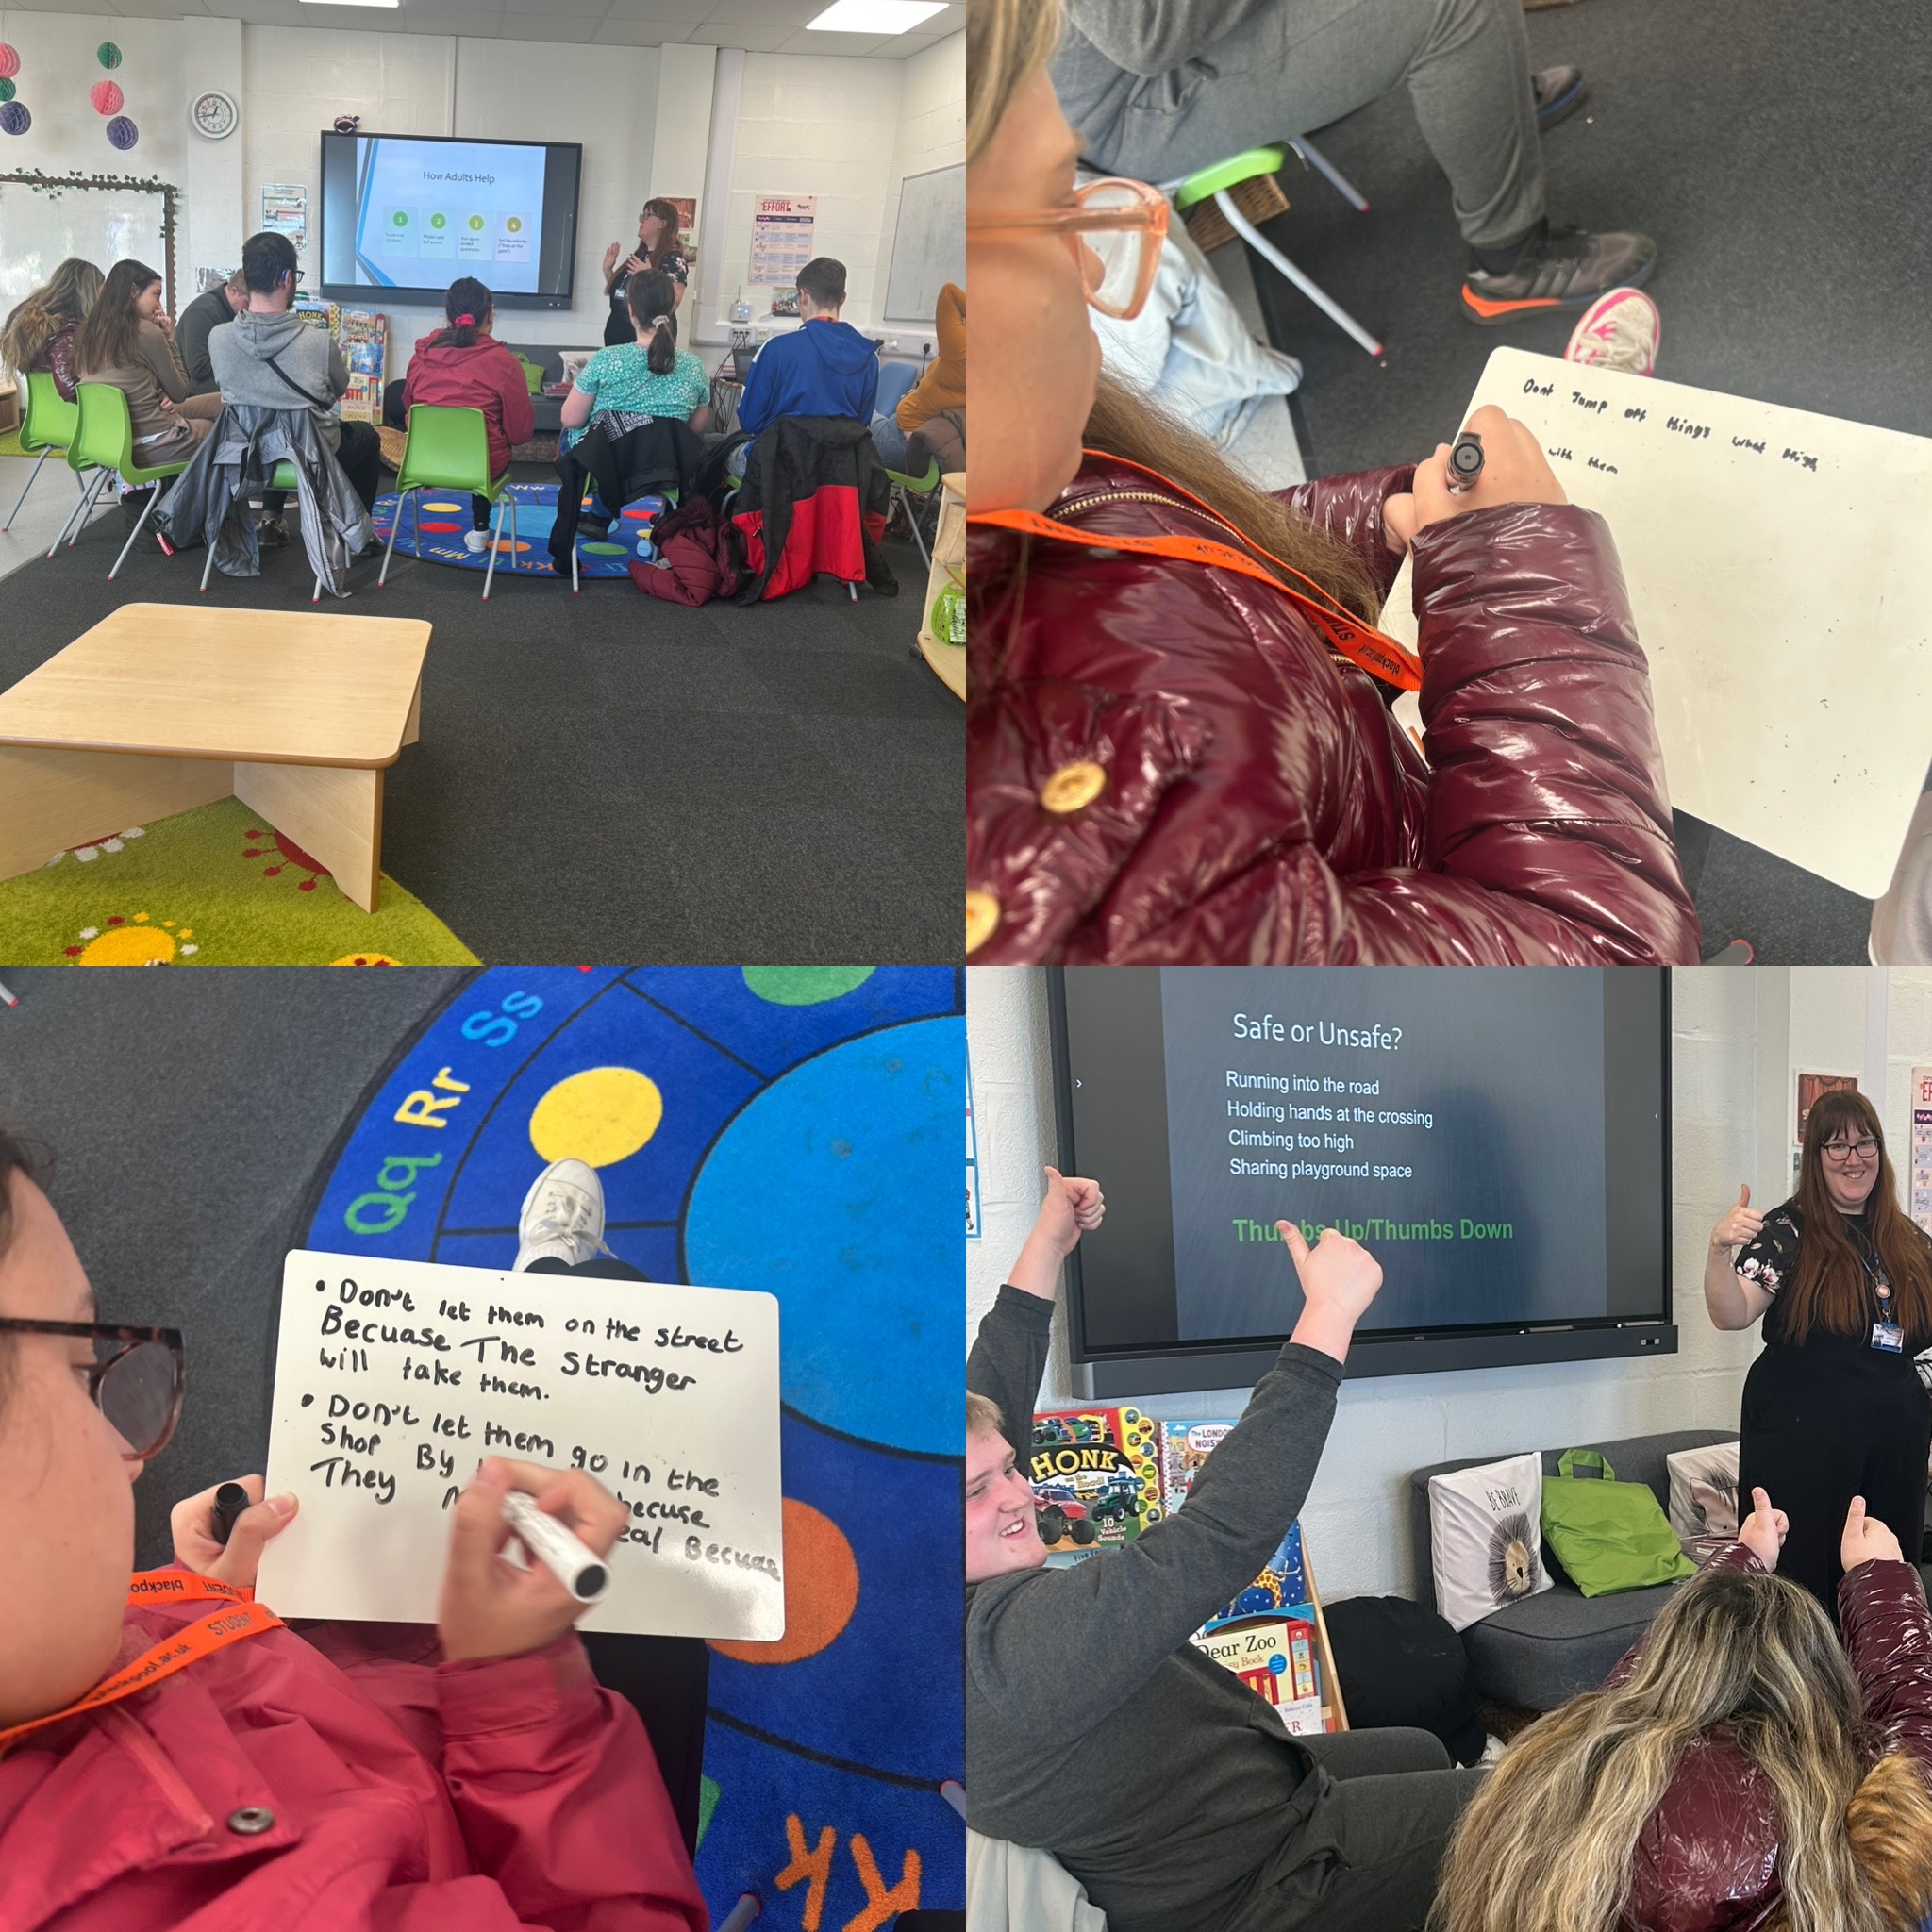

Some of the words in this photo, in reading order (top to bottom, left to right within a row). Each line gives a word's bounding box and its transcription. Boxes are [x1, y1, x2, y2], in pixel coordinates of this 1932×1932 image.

[423, 171, 443, 180] How
[444, 172, 473, 182] Adults
[475, 174, 495, 185] Help
[761, 201, 791, 212] EFFORT
[1233, 1013, 1285, 1041] Safe
[1291, 1024, 1314, 1043] or
[1319, 1020, 1403, 1050] Unsafe?
[1226, 1070, 1289, 1094] Running
[1293, 1074, 1319, 1091] into
[1323, 1078, 1345, 1093] the
[1349, 1080, 1380, 1095] road
[394, 1066, 470, 1128] Rr
[1227, 1100, 1284, 1122] Holding
[1289, 1103, 1332, 1120] hands
[1336, 1107, 1350, 1121] at
[1354, 1107, 1375, 1123] the
[1378, 1109, 1433, 1129] crossing
[1228, 1129, 1293, 1151] Climbing
[1298, 1133, 1320, 1148] too
[1324, 1133, 1354, 1153] high
[1230, 1158, 1288, 1179] Sharing
[1292, 1160, 1369, 1180] playground
[1373, 1164, 1413, 1181] space
[344, 1151, 443, 1235] Qq
[1232, 1219, 1326, 1242] Thubs
[1460, 1218, 1513, 1240] Down
[439, 1299, 471, 1321] let
[487, 1304, 545, 1329] them
[565, 1318, 595, 1334] on
[606, 1317, 641, 1342] the
[321, 1304, 451, 1351] Becuase
[460, 1336, 536, 1366] The
[561, 1351, 697, 1394] Stranger
[320, 1347, 368, 1372] will
[403, 1356, 462, 1385] take
[480, 1373, 550, 1400] them.
[329, 1394, 419, 1426] Don't
[432, 1413, 471, 1439] let
[484, 1421, 554, 1457] them
[570, 1446, 608, 1473] go
[622, 1461, 651, 1484] in
[667, 1468, 719, 1497] the
[1202, 1429, 1231, 1438] LONDO
[417, 1443, 455, 1479] By
[1030, 1449, 1120, 1482] HONK
[310, 1457, 396, 1504] They
[1486, 1491, 1501, 1511] BE
[1495, 1487, 1520, 1509] BRAVE
[1100, 1526, 1127, 1534] Vehicle
[1102, 1518, 1114, 1527] 10
[616, 1525, 663, 1554] eal
[208, 1612, 253, 1636] STUDENT
[1246, 1635, 1277, 1652] Zoo
[1241, 1654, 1264, 1666] Book
